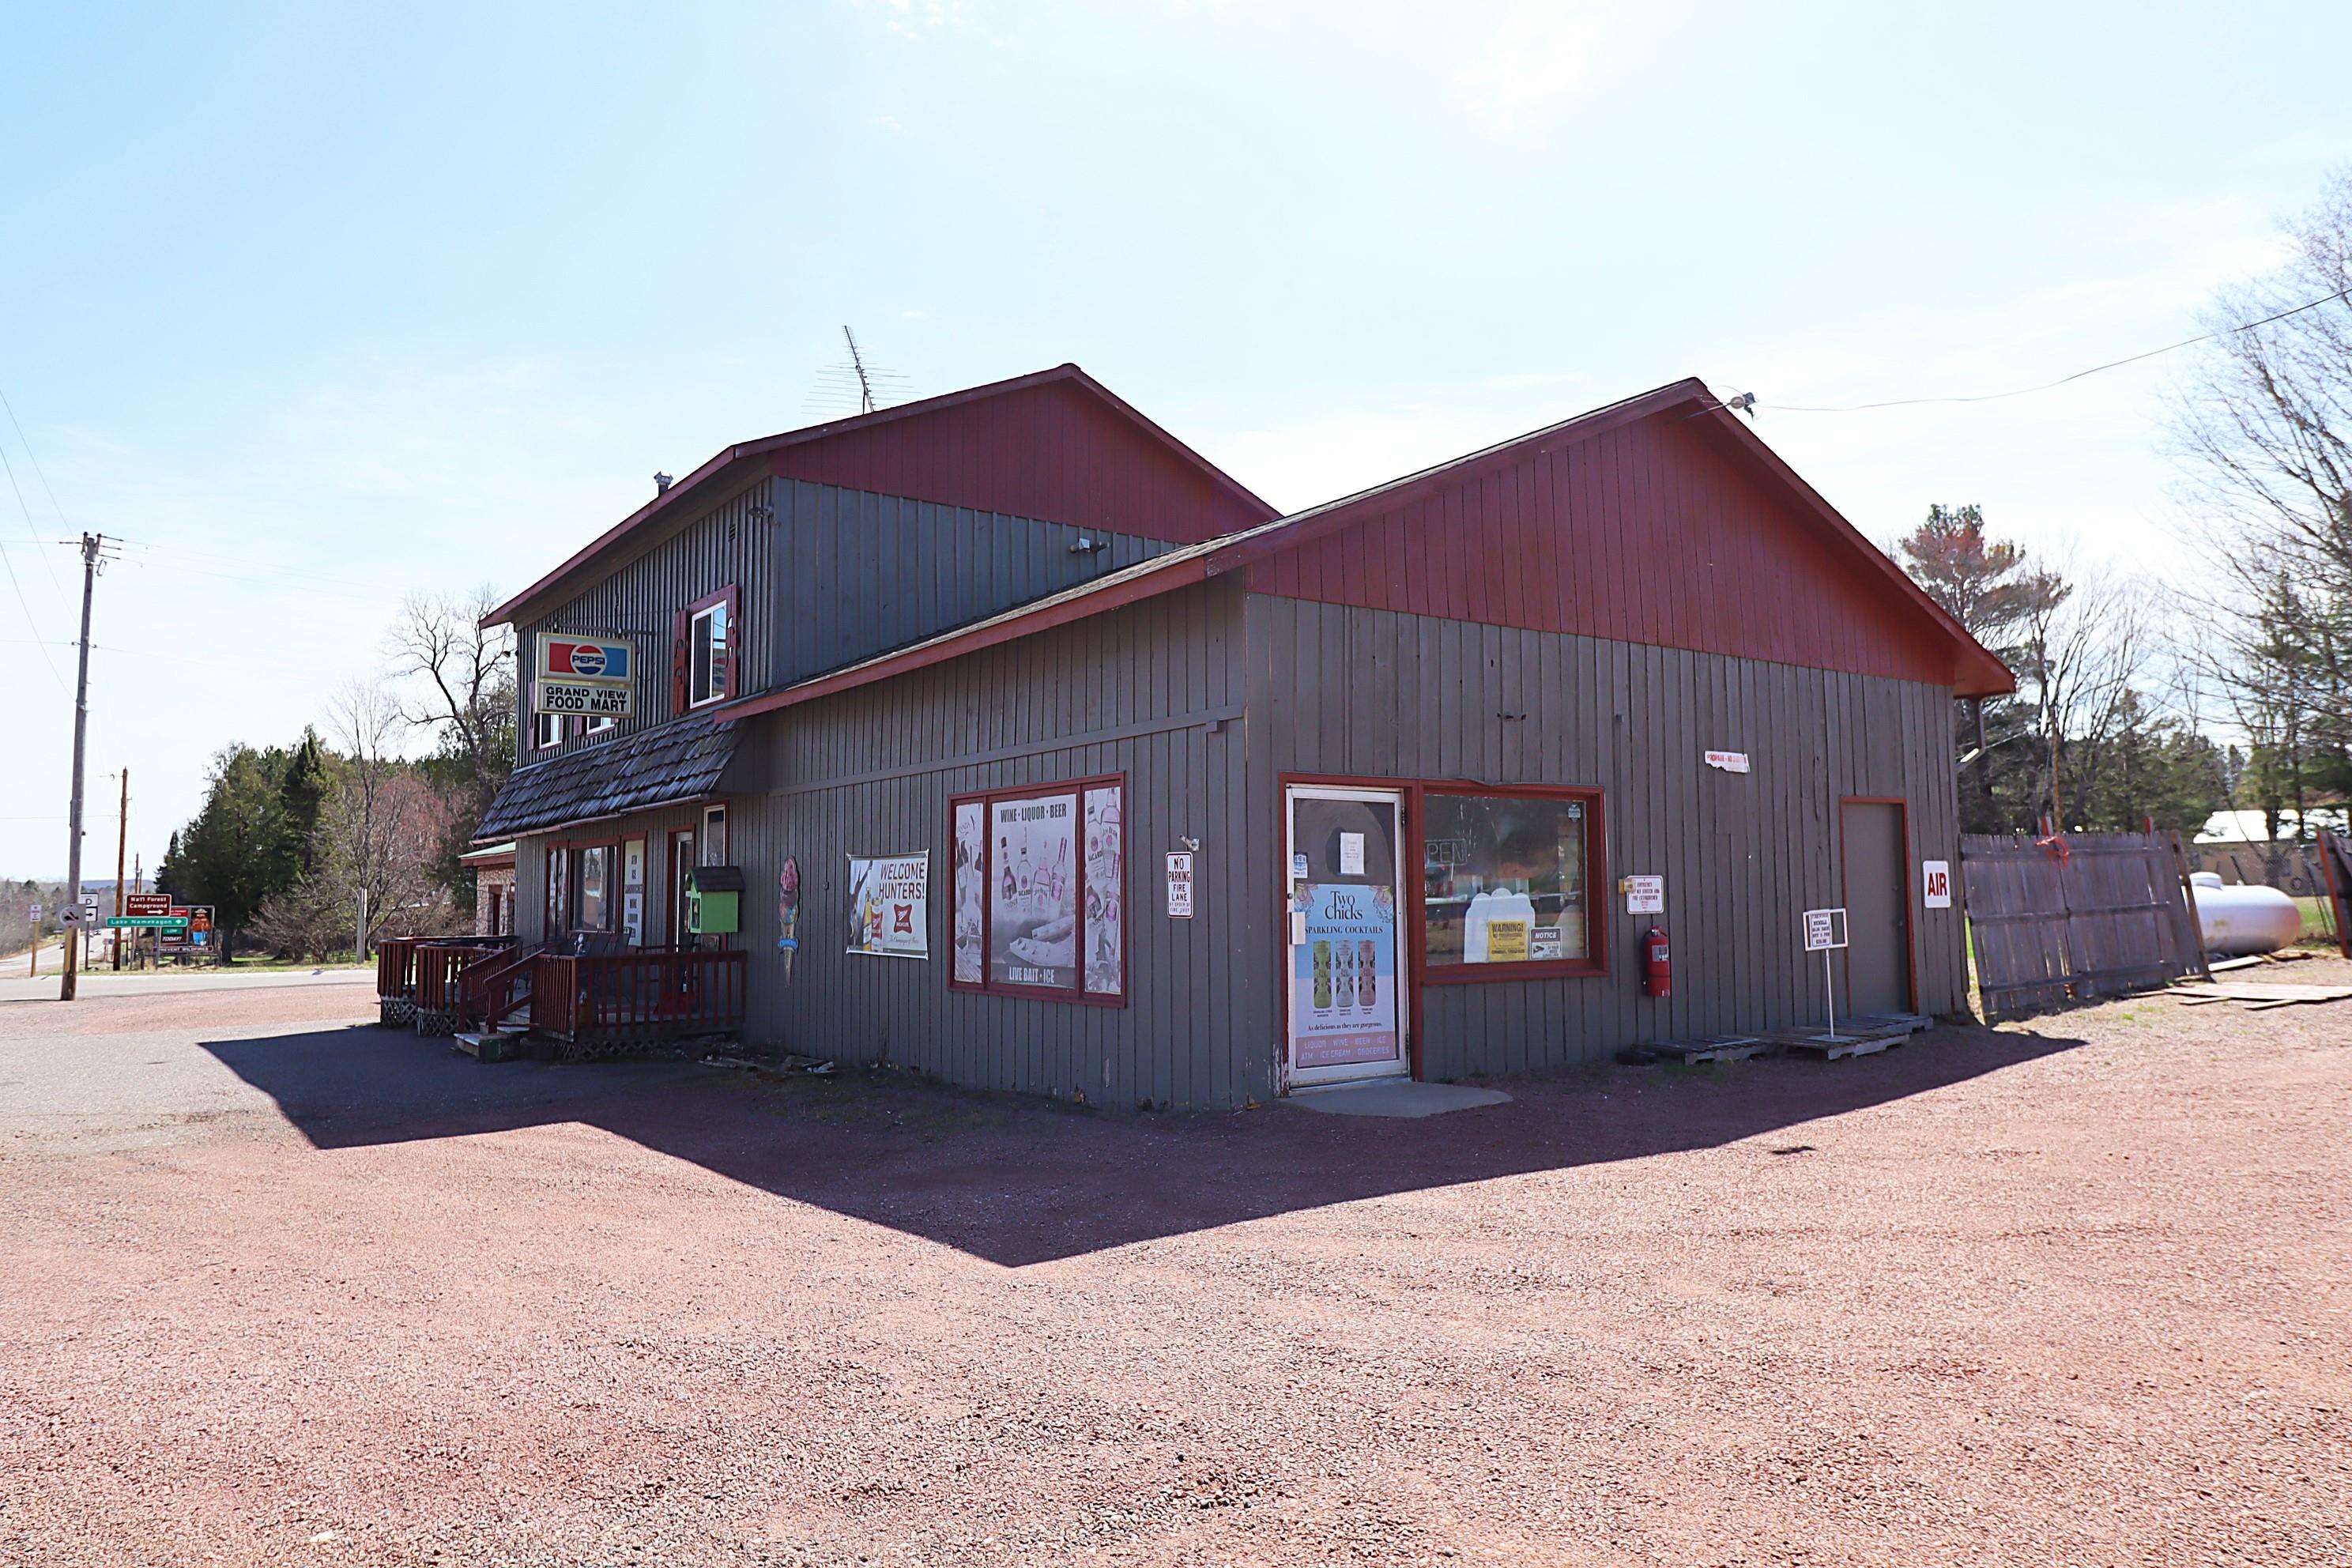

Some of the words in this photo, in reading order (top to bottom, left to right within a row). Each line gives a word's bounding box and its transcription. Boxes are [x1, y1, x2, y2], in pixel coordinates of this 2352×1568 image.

[571, 655, 605, 665] PEPSI
[546, 687, 590, 697] GRAND
[597, 689, 627, 699] VIEW
[546, 695, 584, 710] FOOD
[590, 699, 627, 711] MART
[1001, 808, 1016, 823] WINE
[1021, 805, 1045, 822] LIQUOR
[1050, 803, 1067, 819] BEER
[1425, 842, 1464, 862] PEN
[880, 862, 925, 880] WELCOME
[1174, 858, 1184, 869] NO
[1169, 871, 1190, 883] PARKING
[1928, 872, 1947, 896] AIR
[879, 882, 925, 899] HUNTERS!
[1173, 884, 1185, 892] FIRE
[1330, 891, 1355, 906] Two
[1325, 904, 1363, 920] Chicks
[1491, 923, 1524, 933] WARNING!
[1008, 967, 1022, 981] LIVE
[1023, 967, 1038, 982] BAIT
[1043, 968, 1055, 984] ICE
